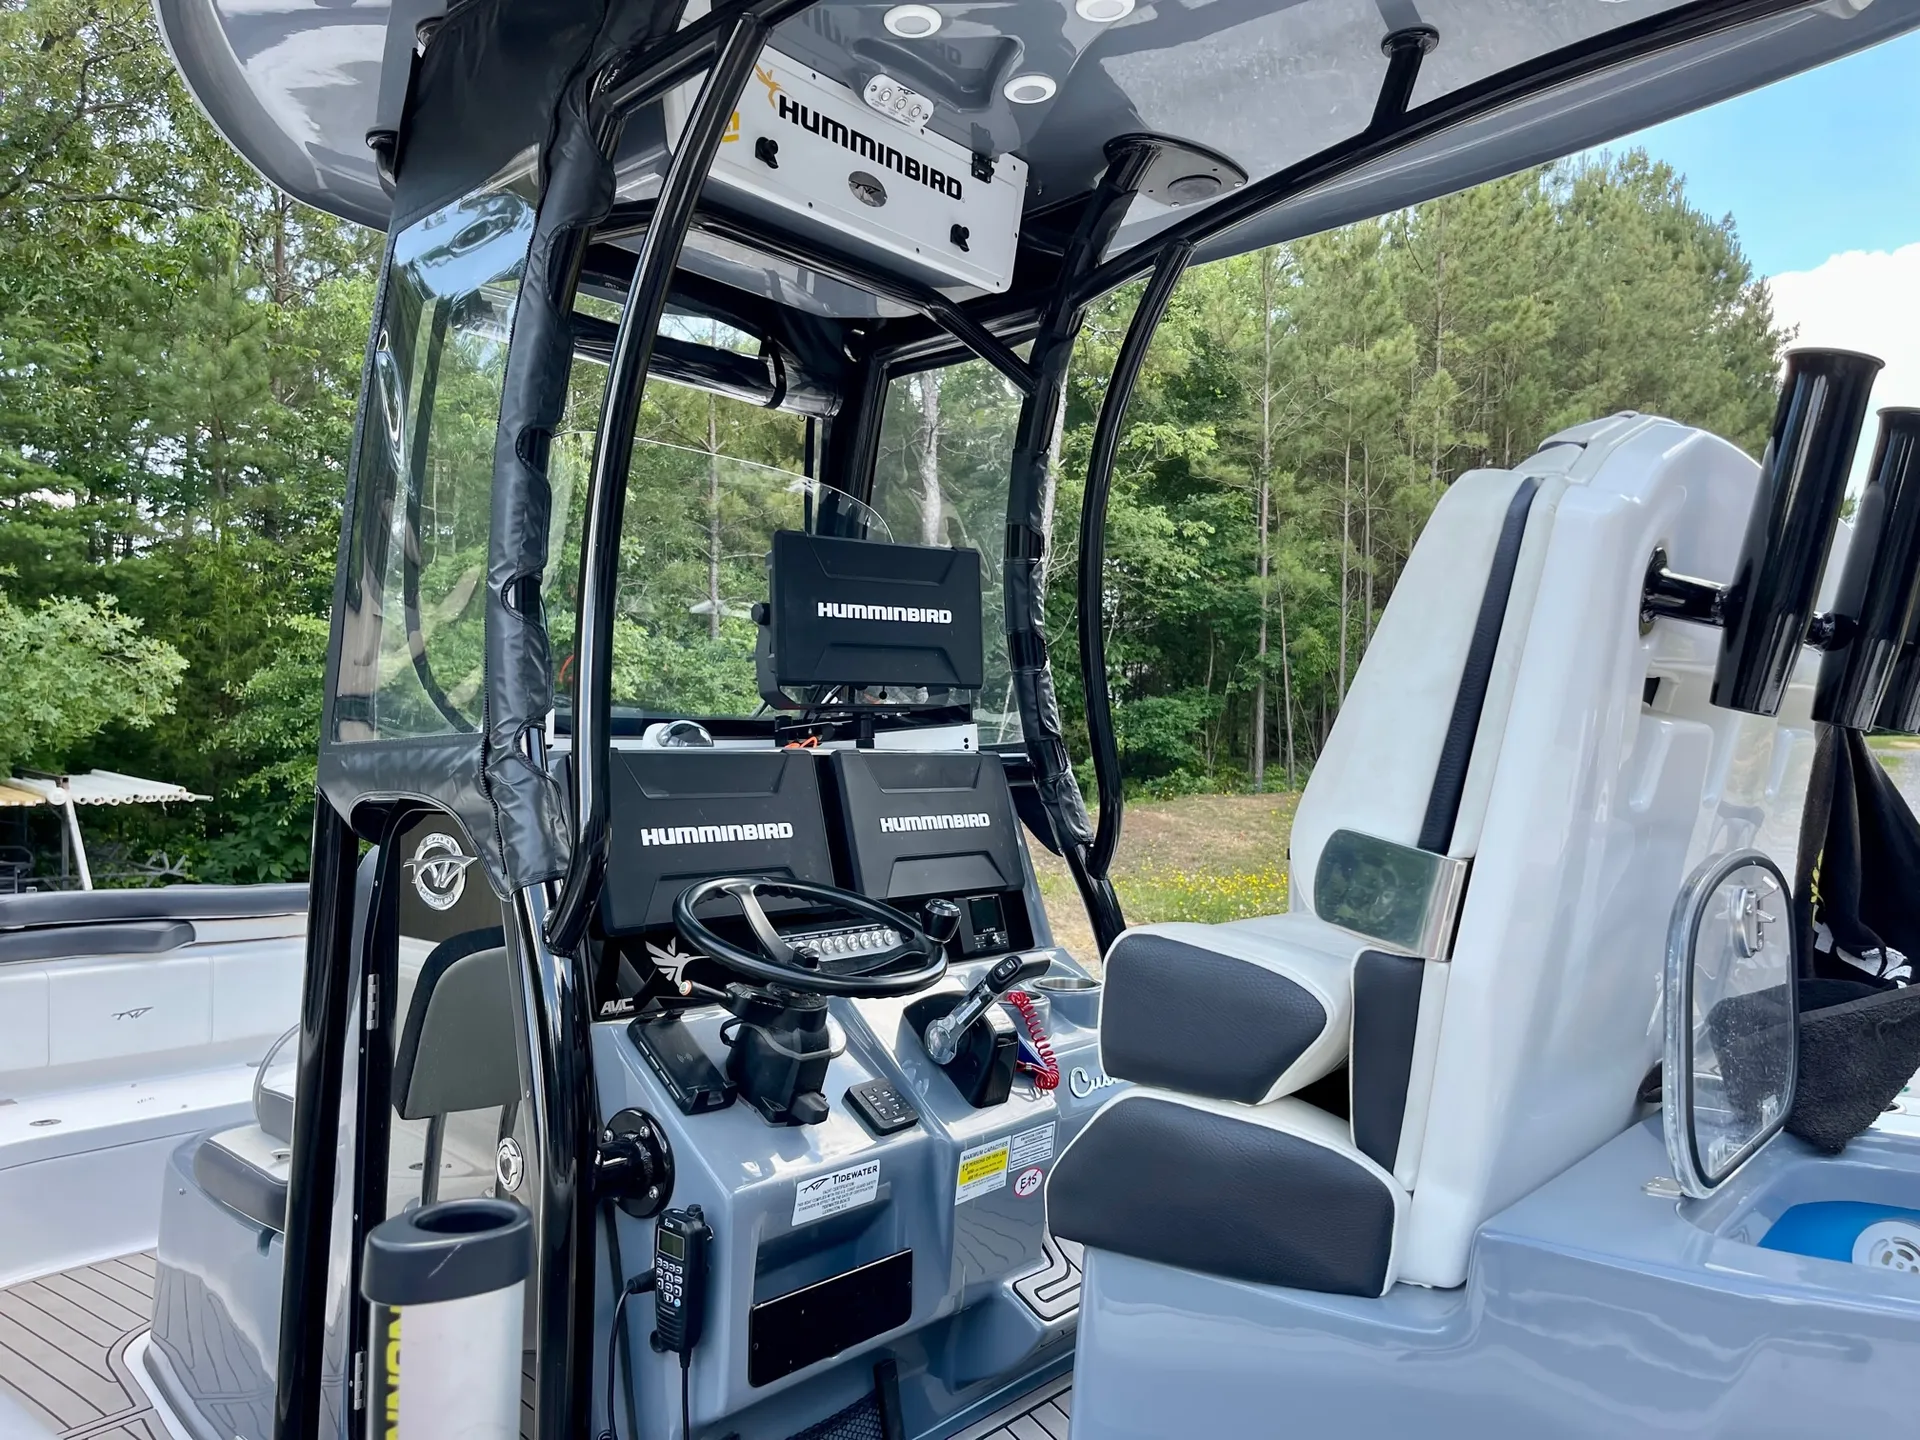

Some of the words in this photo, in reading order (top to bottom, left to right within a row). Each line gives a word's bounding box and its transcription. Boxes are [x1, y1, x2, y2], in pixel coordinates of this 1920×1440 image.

[778, 95, 963, 201] HUMMINBIRD
[817, 602, 952, 625] HUMMINBIRD
[641, 822, 794, 847] HUMMINBIRD
[880, 813, 990, 834] HUMMINBIRD
[832, 1165, 877, 1184] TIDEWATER
[1020, 1174, 1037, 1189] E15
